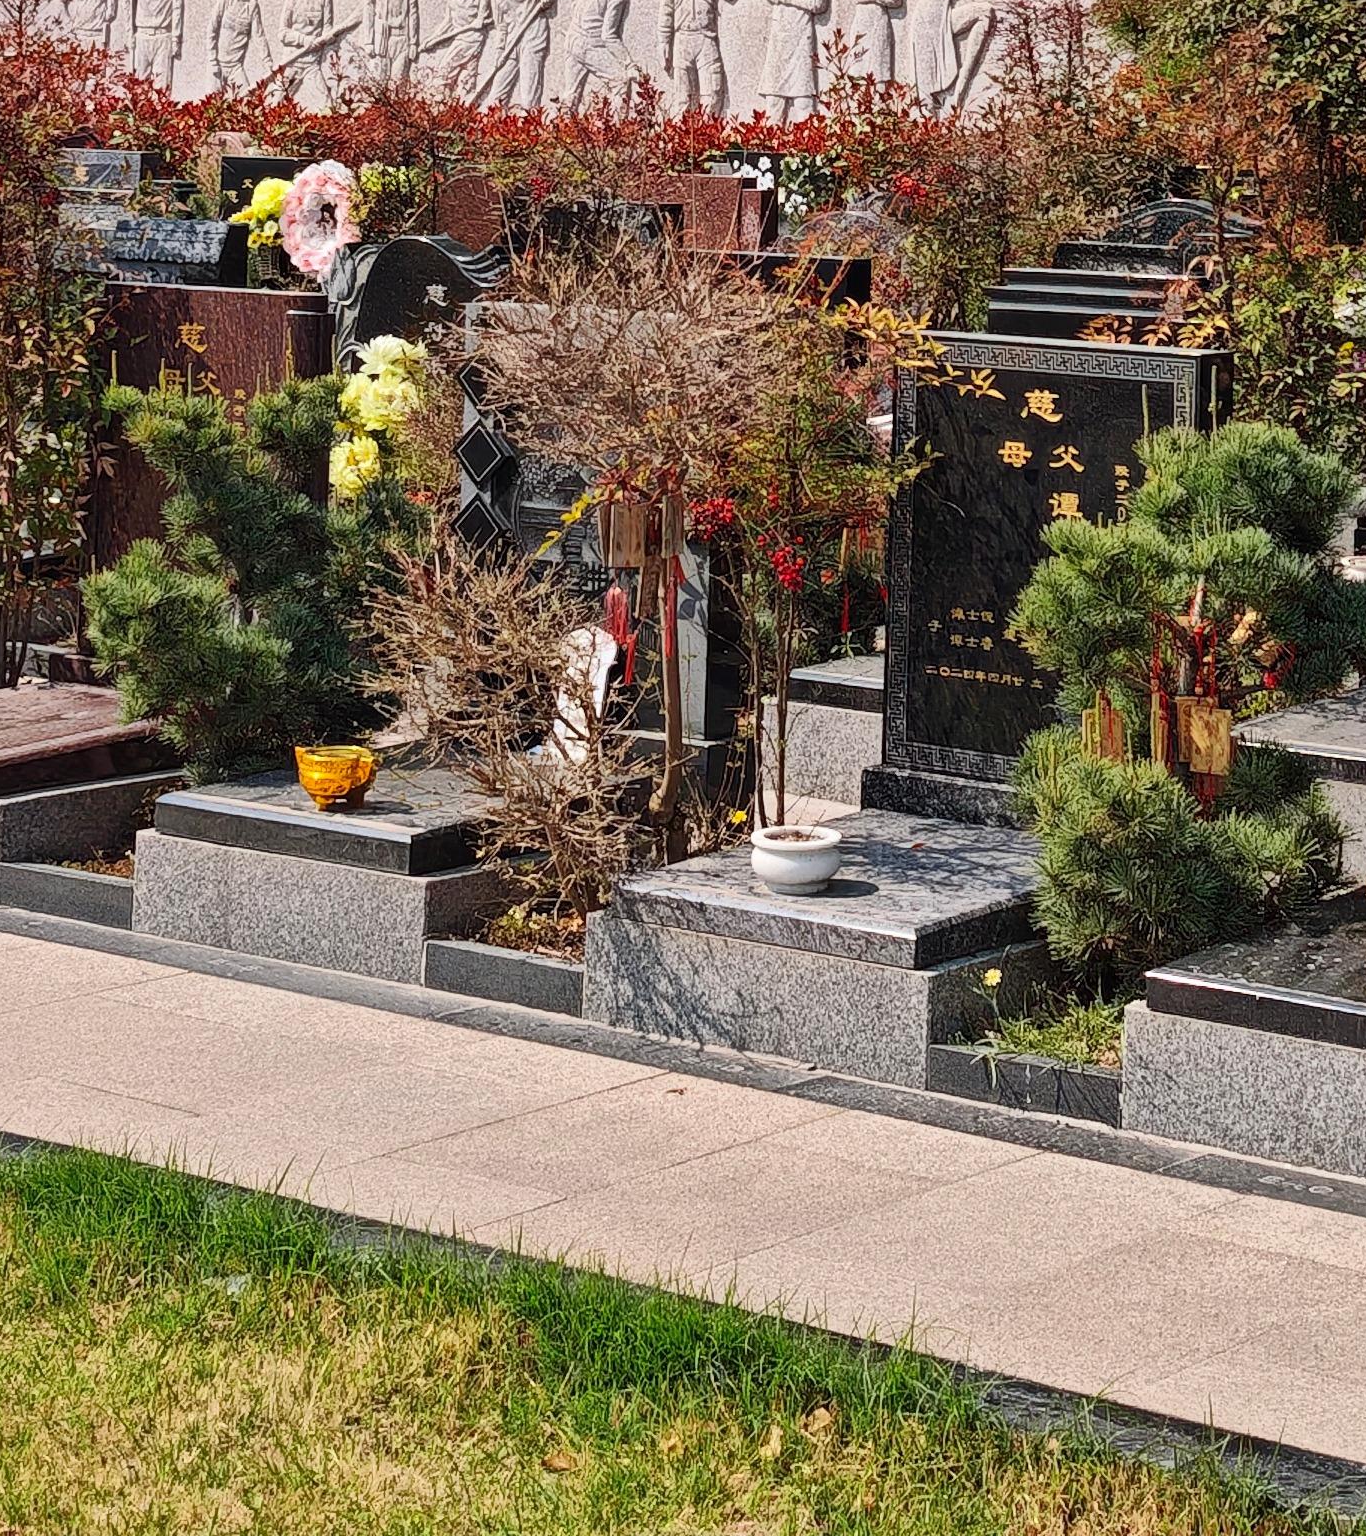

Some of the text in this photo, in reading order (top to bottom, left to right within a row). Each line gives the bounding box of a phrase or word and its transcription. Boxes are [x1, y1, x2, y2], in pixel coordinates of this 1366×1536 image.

[175, 322, 209, 354] 慈
[193, 370, 222, 396] 父
[1020, 389, 1064, 423] 慈
[998, 440, 1033, 468] 母
